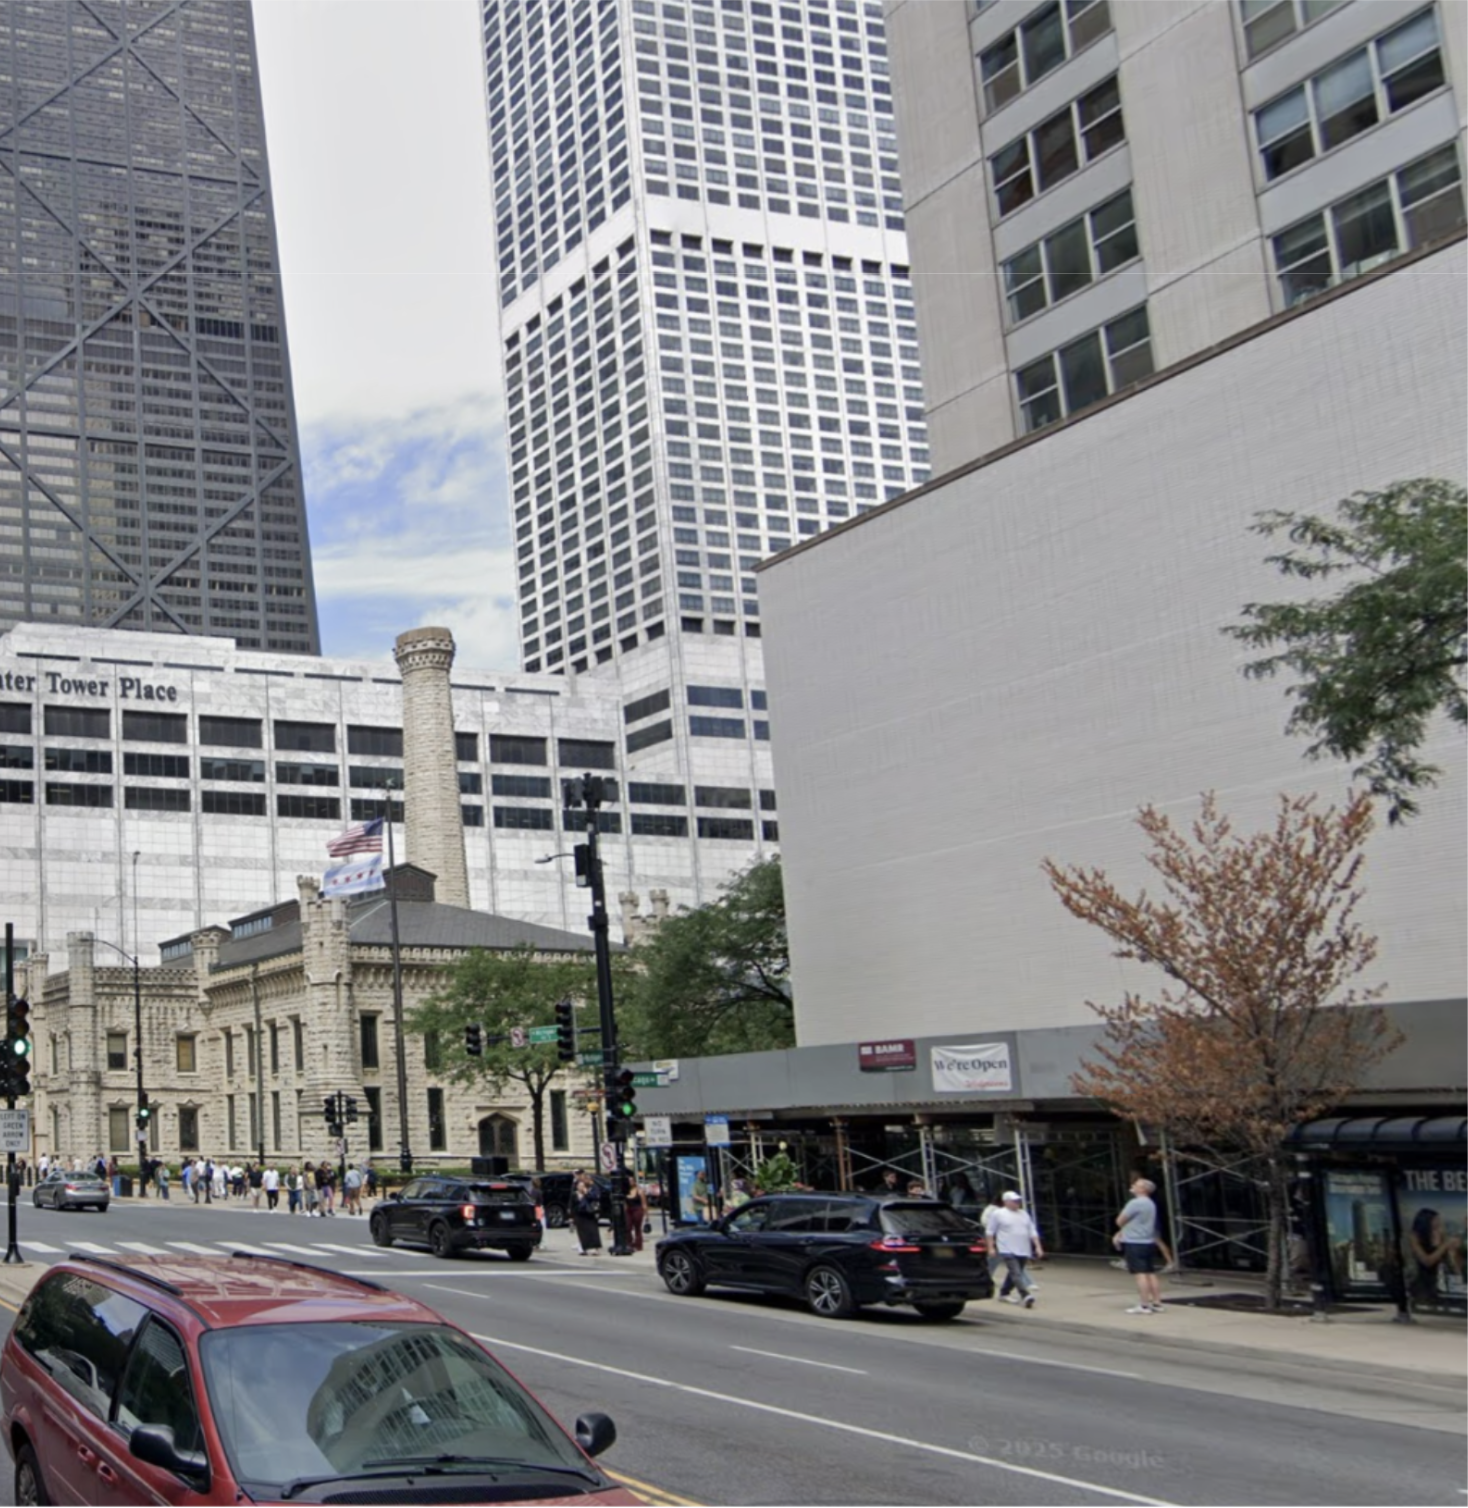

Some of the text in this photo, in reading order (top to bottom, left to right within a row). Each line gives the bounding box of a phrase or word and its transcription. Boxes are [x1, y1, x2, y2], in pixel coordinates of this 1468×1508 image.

[45, 672, 109, 697] Tower
[119, 677, 177, 701] Place
[934, 1058, 1007, 1073] We're Open
[1404, 1170, 1440, 1191] THE
[1442, 1170, 1468, 1191] BE
